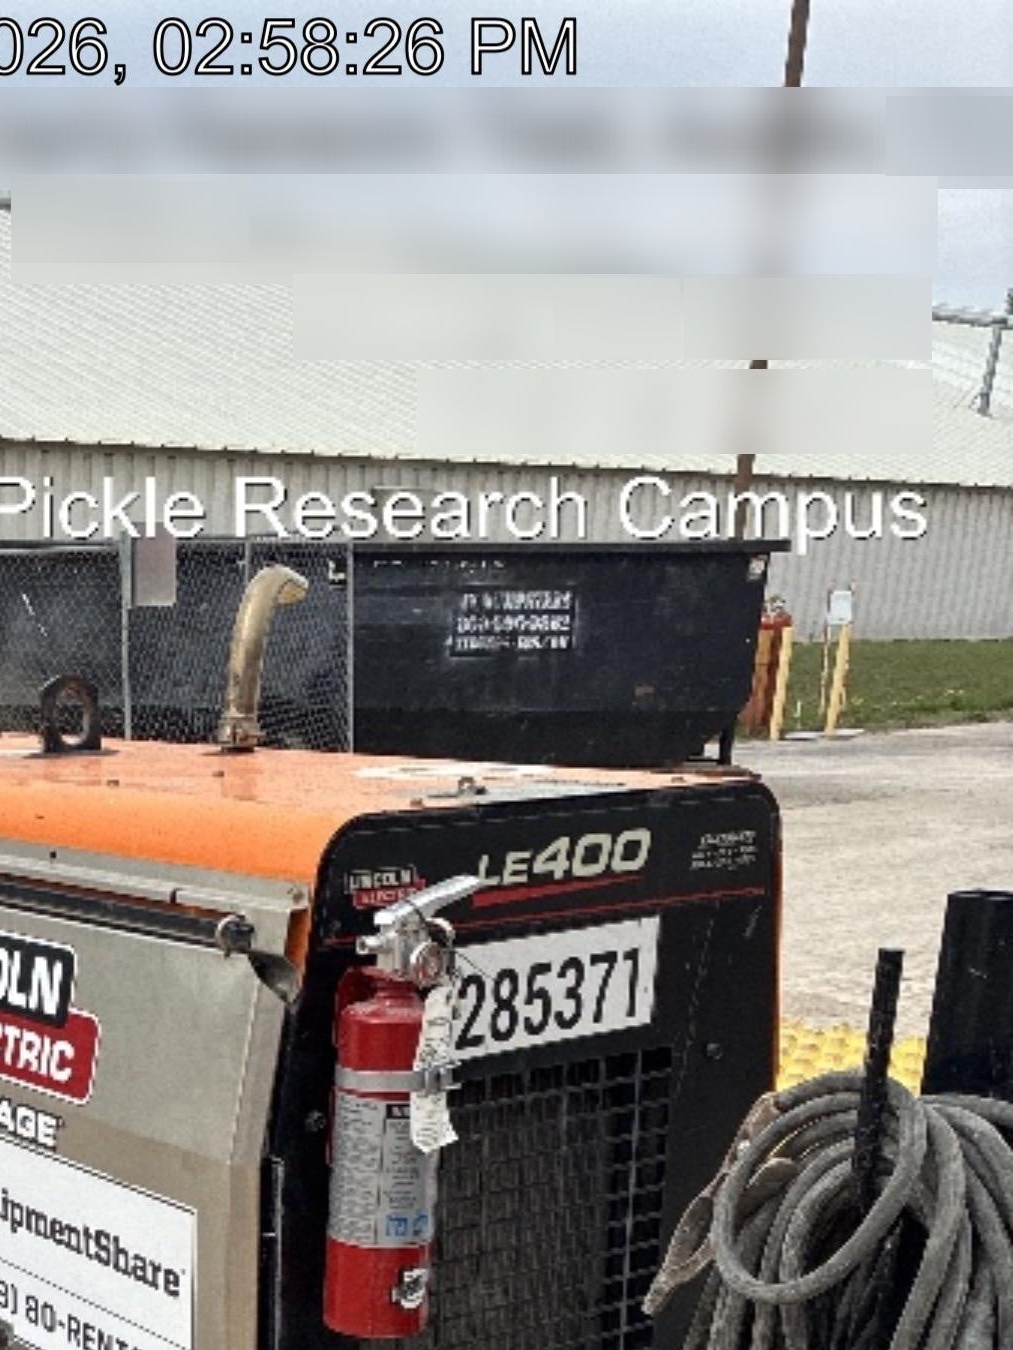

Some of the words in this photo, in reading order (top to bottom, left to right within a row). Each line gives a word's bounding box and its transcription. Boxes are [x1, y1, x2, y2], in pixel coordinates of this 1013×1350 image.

[349, 869, 412, 890] LINCOLN
[477, 827, 652, 885] LE400
[455, 947, 640, 1050] 285371
